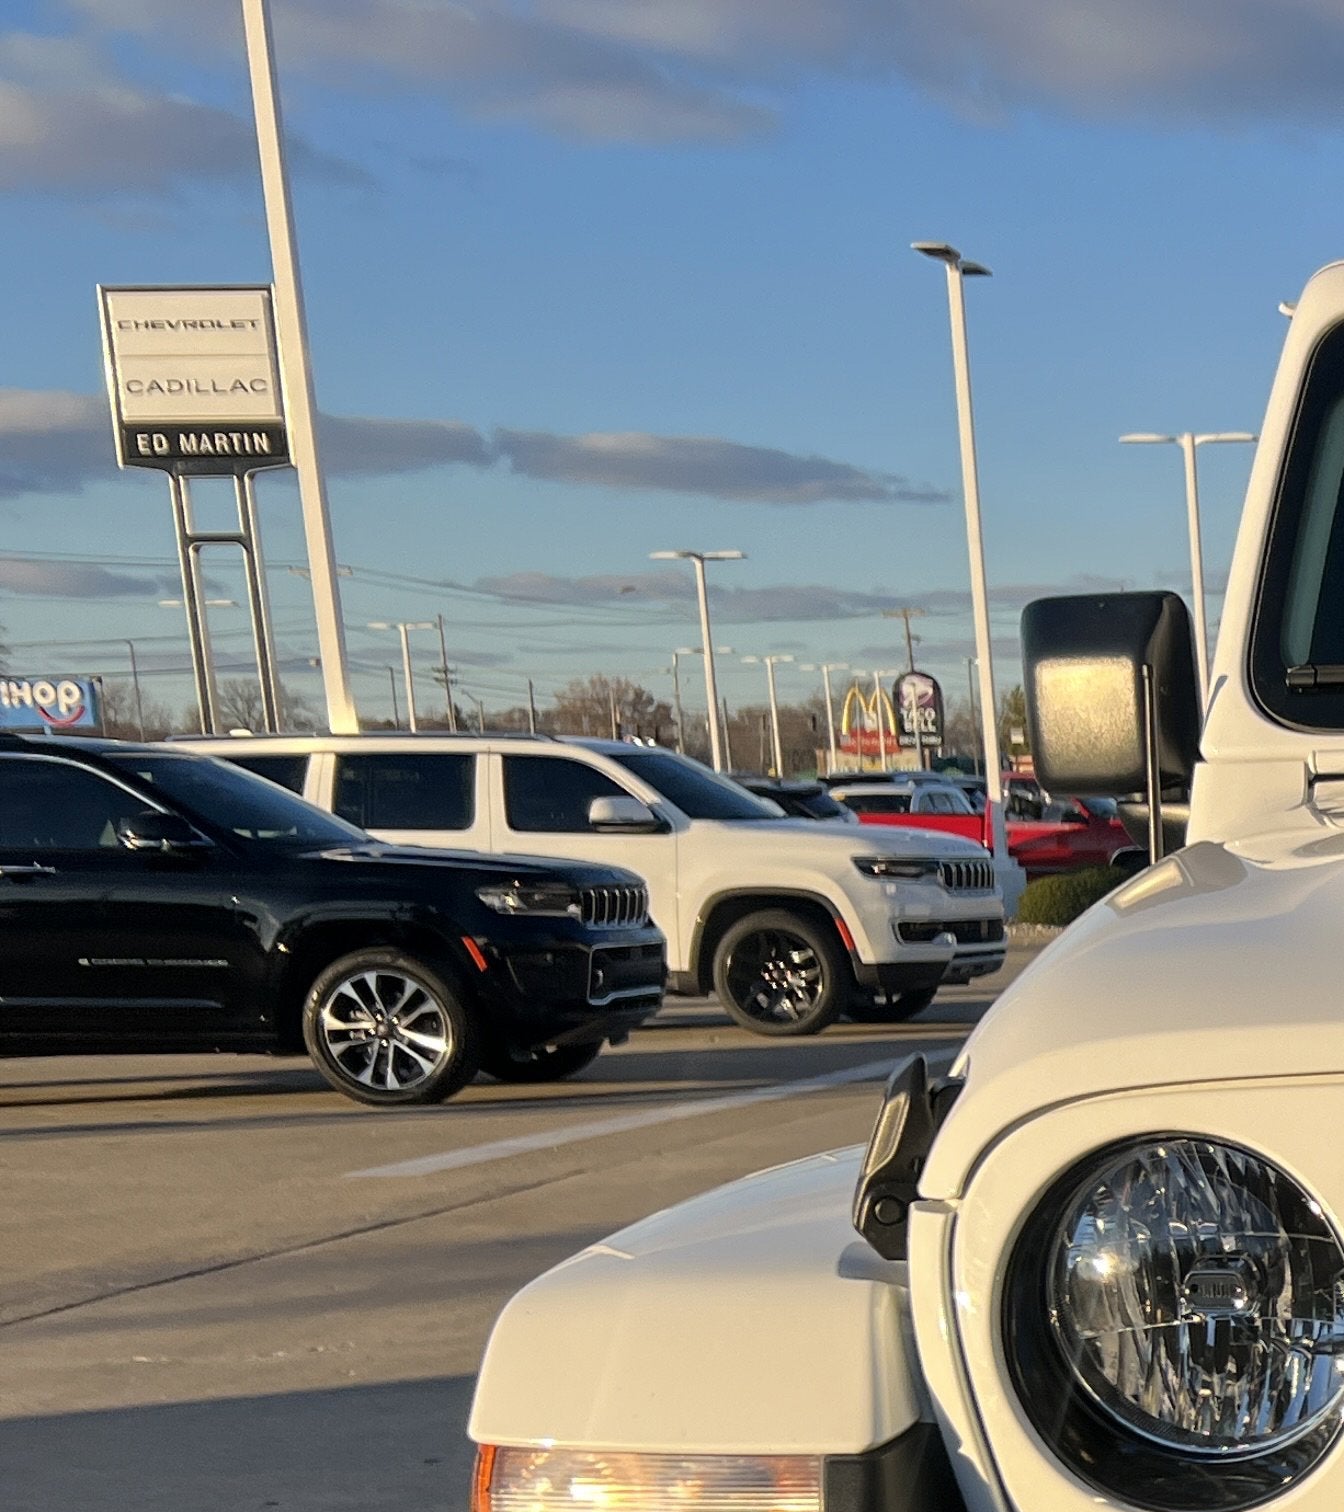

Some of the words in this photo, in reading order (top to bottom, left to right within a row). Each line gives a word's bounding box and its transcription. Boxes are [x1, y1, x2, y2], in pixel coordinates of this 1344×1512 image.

[117, 319, 260, 331] CHEVROLET
[126, 378, 268, 394] CADILLAC
[136, 433, 170, 456] ED
[179, 432, 272, 456] MARTIN
